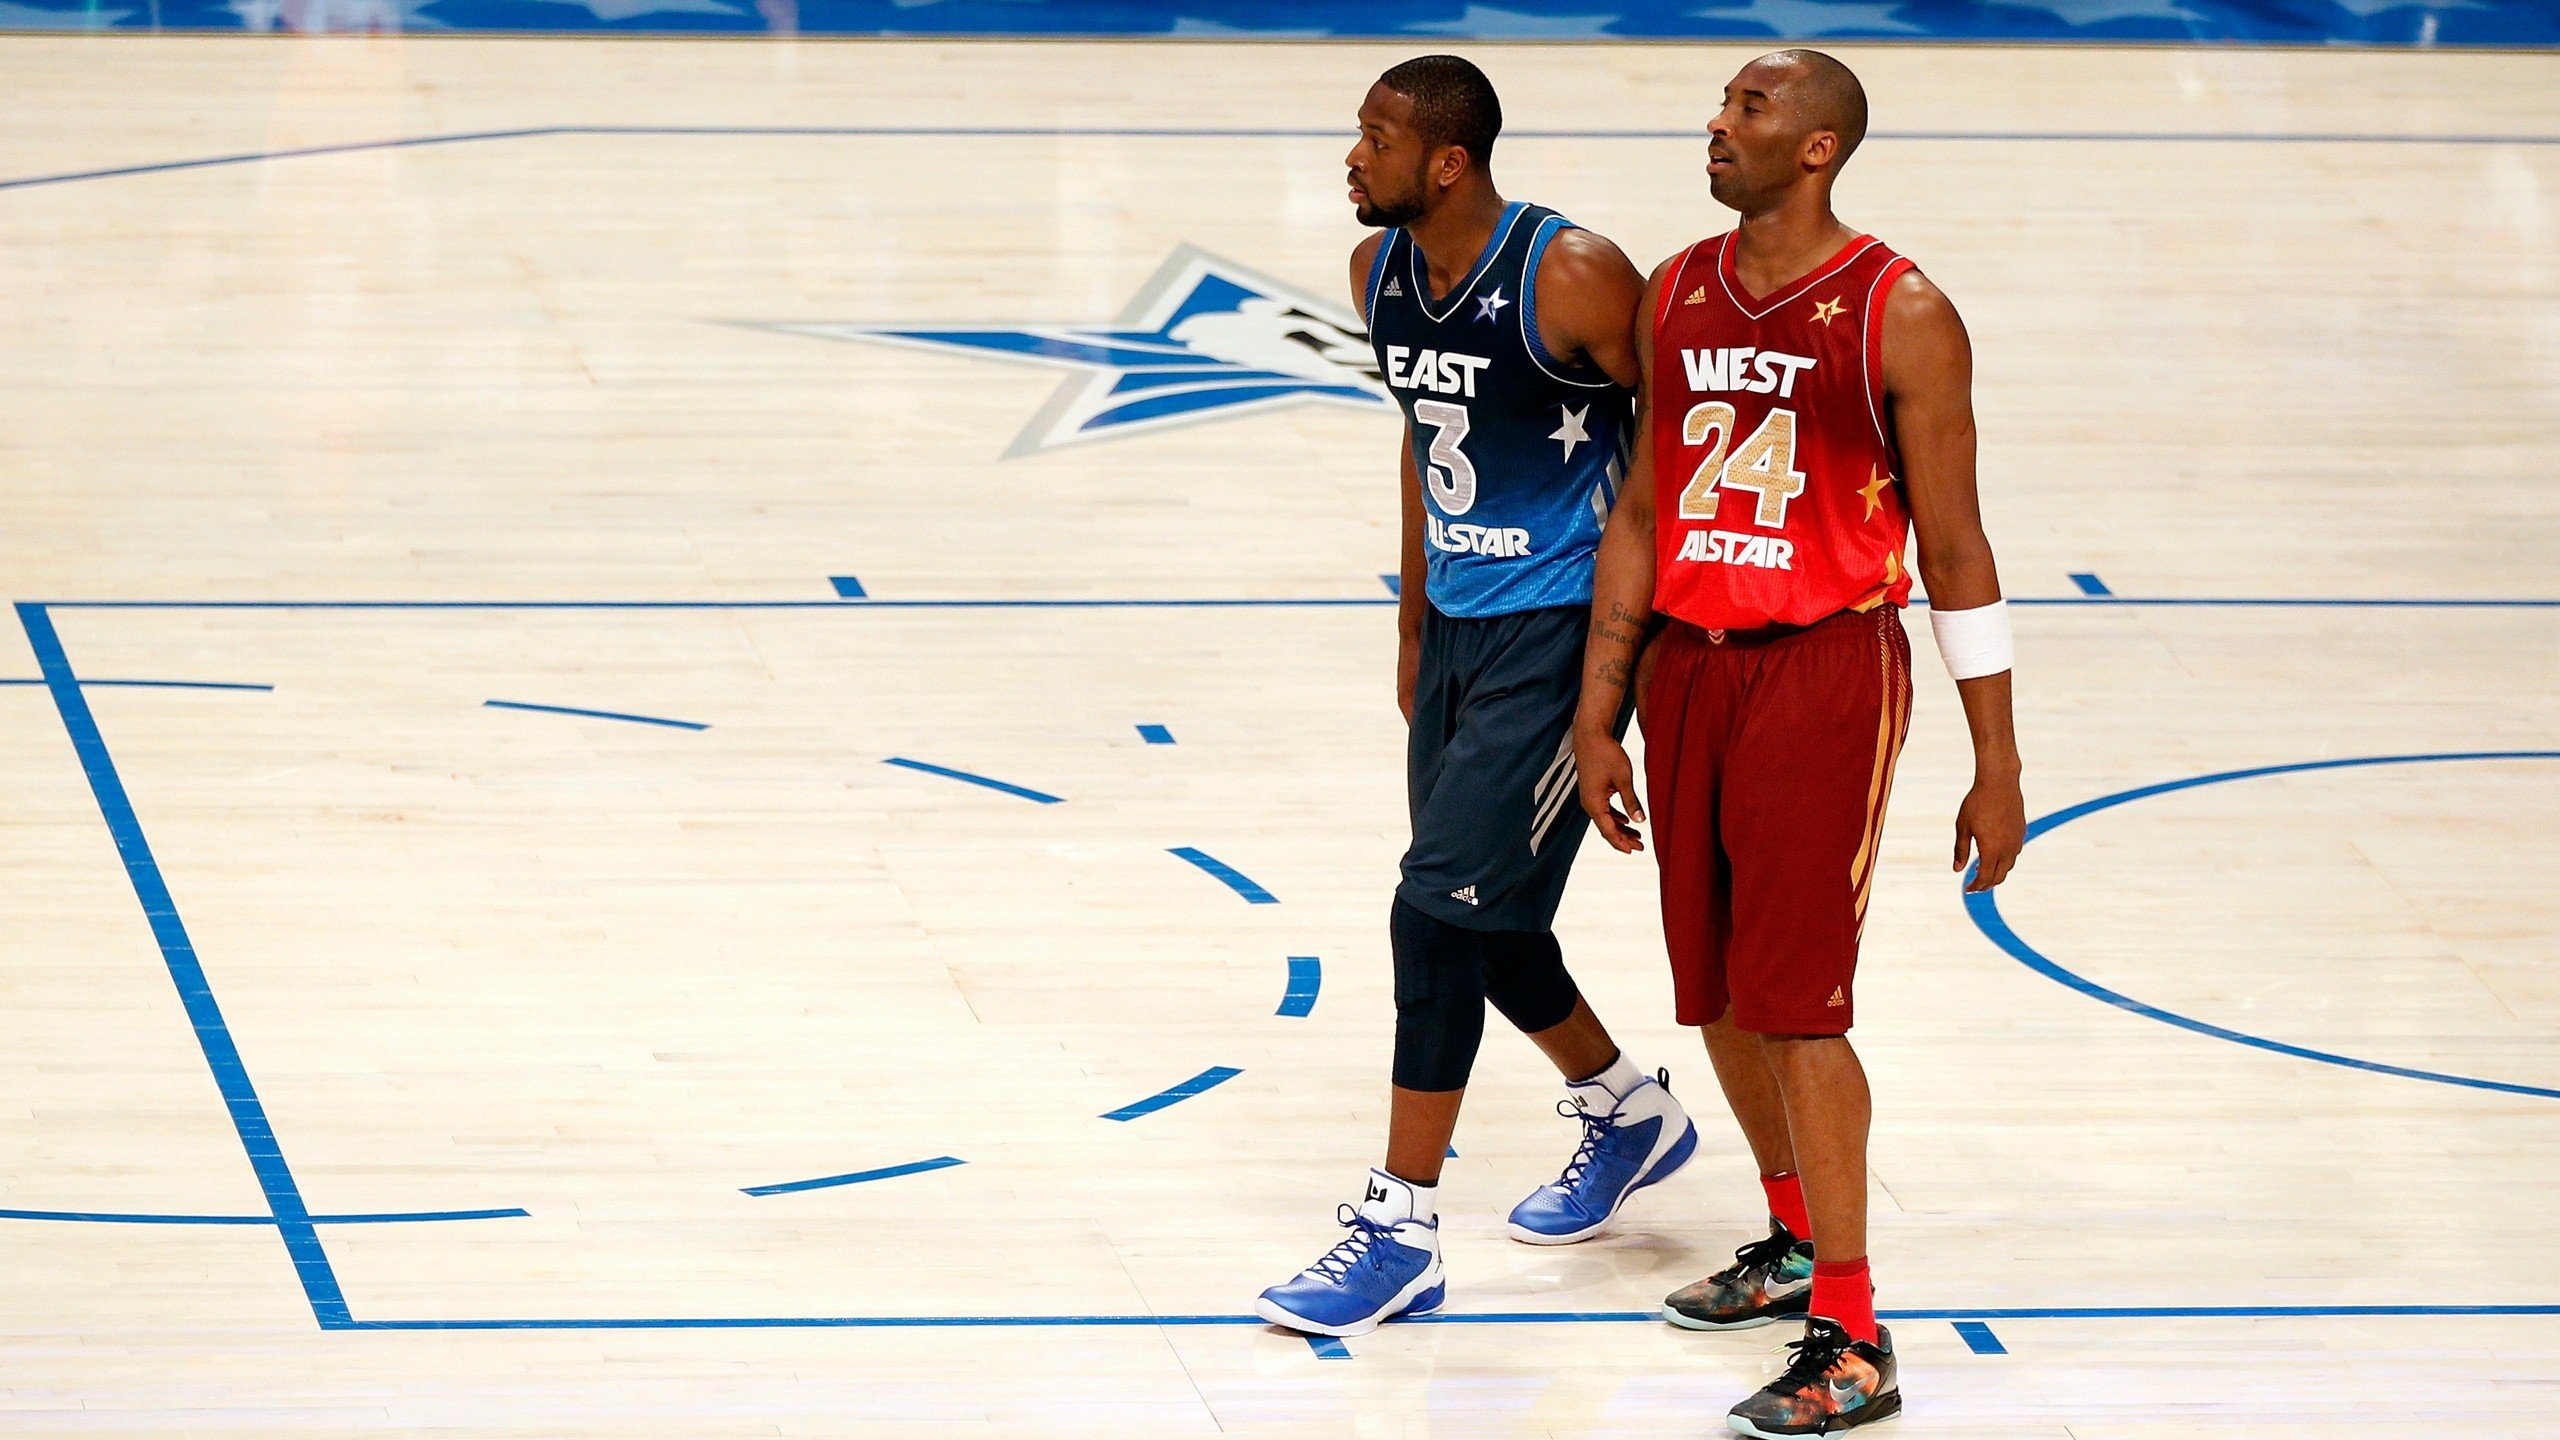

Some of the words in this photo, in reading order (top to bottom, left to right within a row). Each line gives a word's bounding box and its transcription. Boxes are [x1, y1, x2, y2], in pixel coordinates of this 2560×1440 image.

[1386, 344, 1491, 398] EAST
[1680, 346, 1818, 398] WEST
[1413, 398, 1477, 516] 3
[1678, 401, 1807, 530] 24
